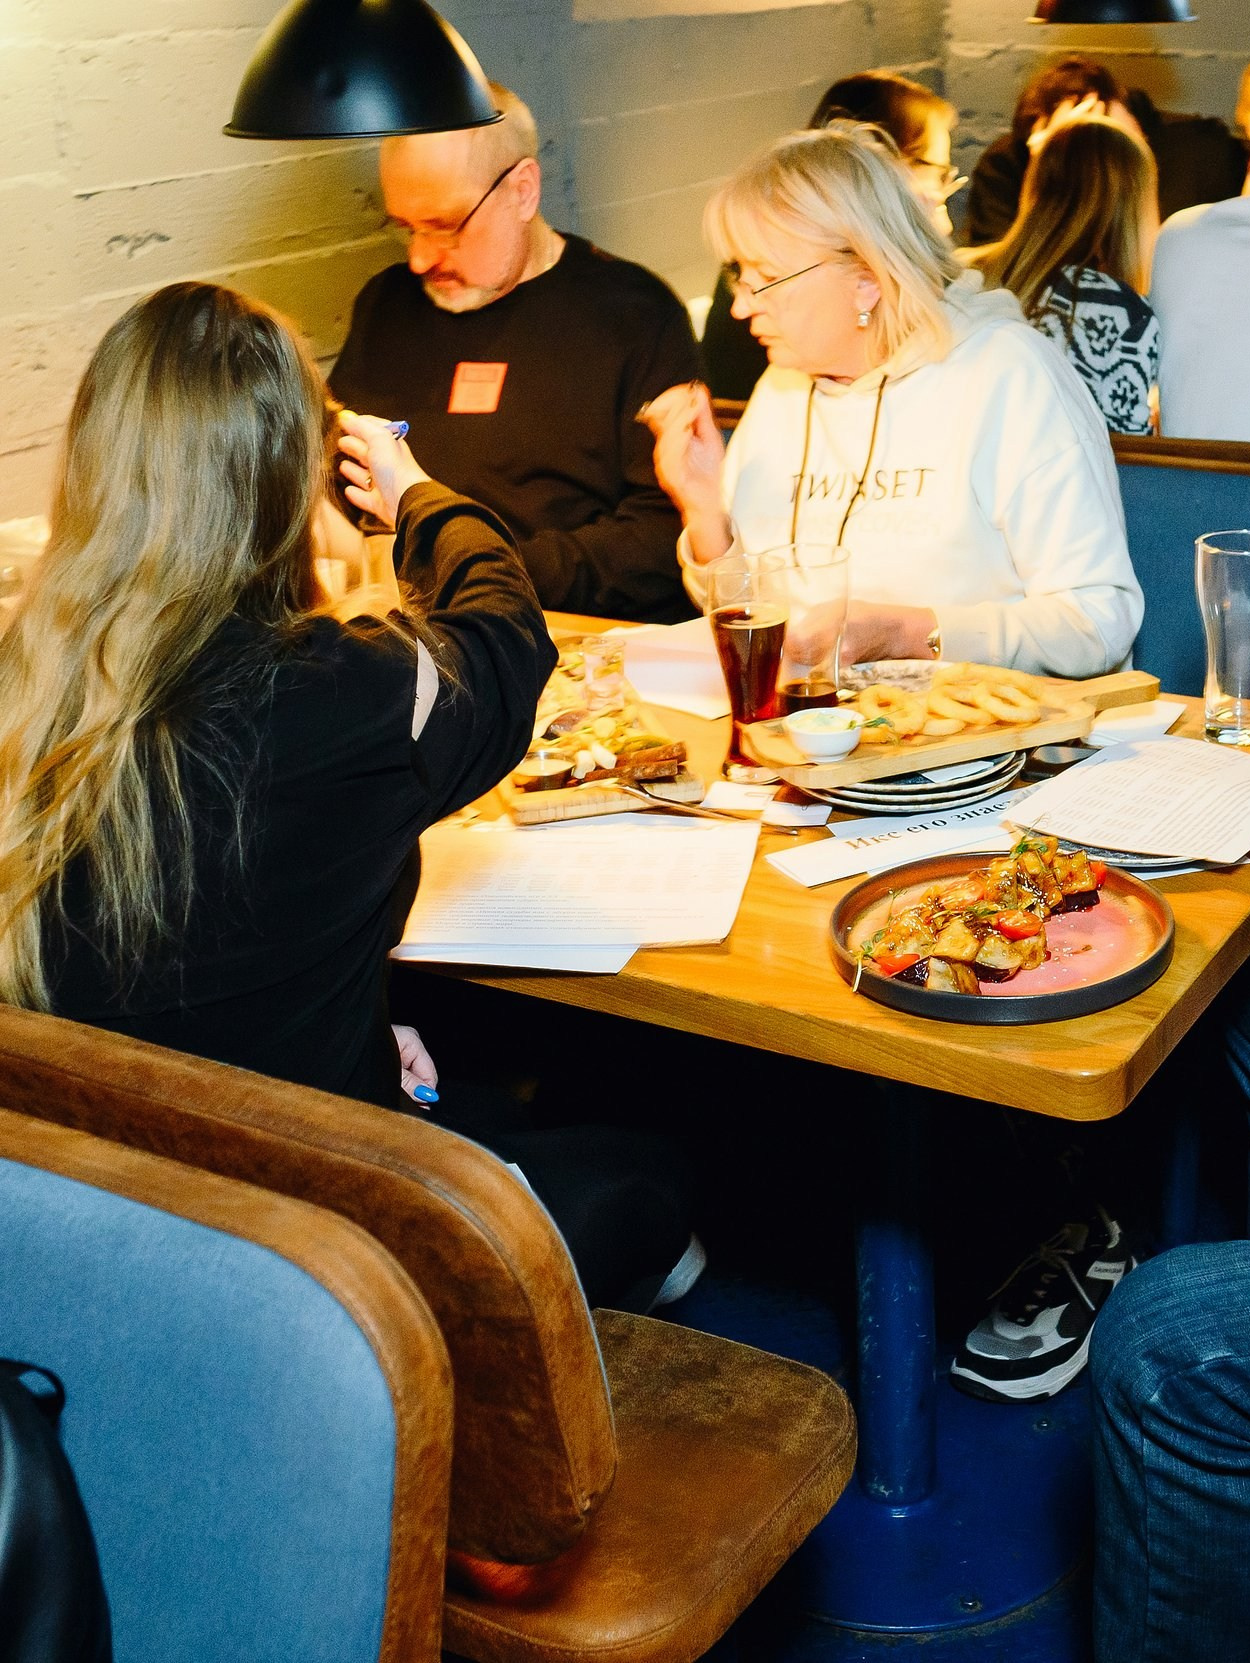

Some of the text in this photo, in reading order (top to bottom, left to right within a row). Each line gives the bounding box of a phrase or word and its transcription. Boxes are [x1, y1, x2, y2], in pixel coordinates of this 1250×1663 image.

[845, 800, 1011, 850] Икс его знае
